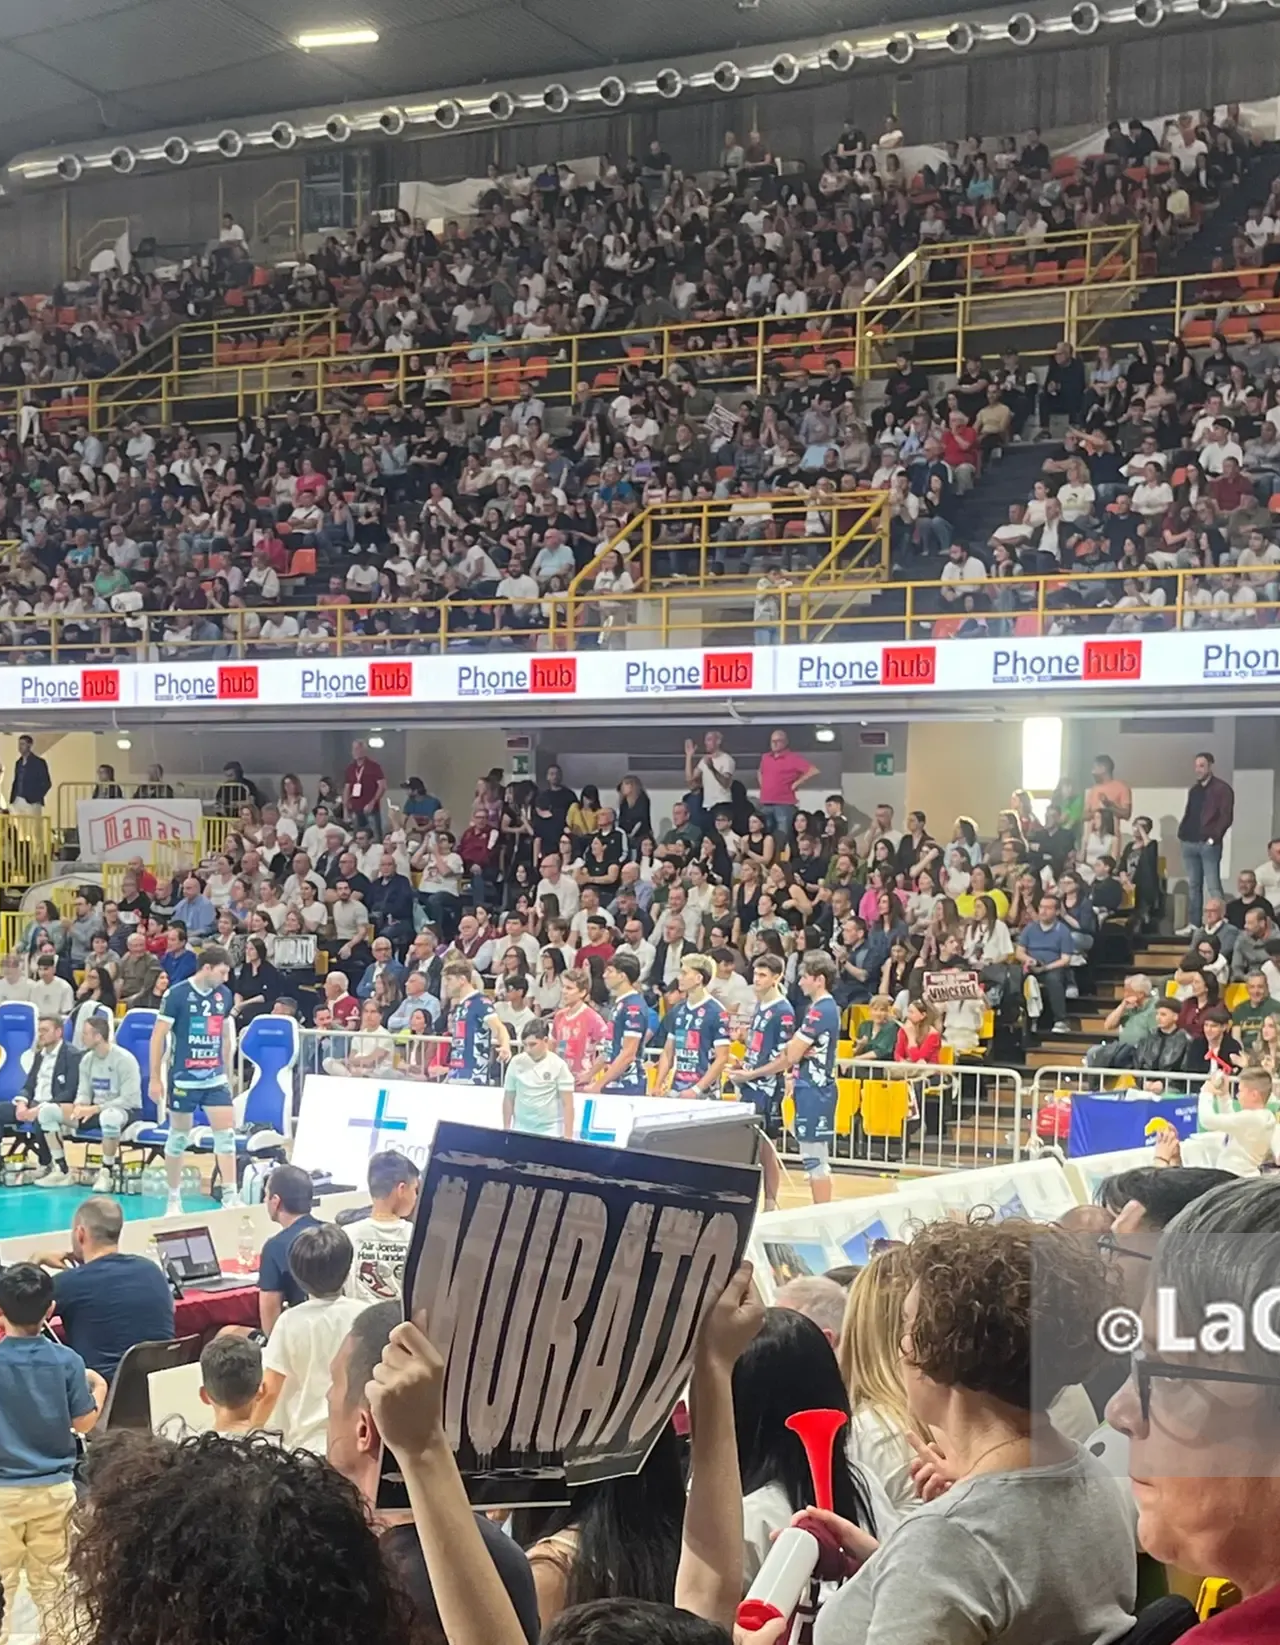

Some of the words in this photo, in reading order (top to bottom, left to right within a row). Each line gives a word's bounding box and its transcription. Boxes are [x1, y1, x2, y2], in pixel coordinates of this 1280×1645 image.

[626, 661, 699, 685] Phone
[707, 657, 748, 682] hub
[799, 656, 878, 681] Phone
[887, 652, 930, 679] hub
[993, 650, 1080, 676] Phone
[1088, 646, 1136, 673] hub
[21, 677, 79, 698] Phone
[83, 673, 115, 695] hub
[155, 673, 215, 694] Phone
[220, 670, 253, 692] hub
[302, 670, 366, 692] Phone
[372, 667, 407, 689] hub
[458, 666, 527, 689] Phone
[533, 663, 571, 686] hub
[202, 1000, 211, 1016] 2
[685, 1014, 693, 1029] 7
[358, 1251, 375, 1260] Has
[377, 1252, 406, 1261] Lande
[361, 1242, 374, 1250] Air
[376, 1242, 407, 1252] Jordan
[412, 1175, 738, 1453] MURATO
